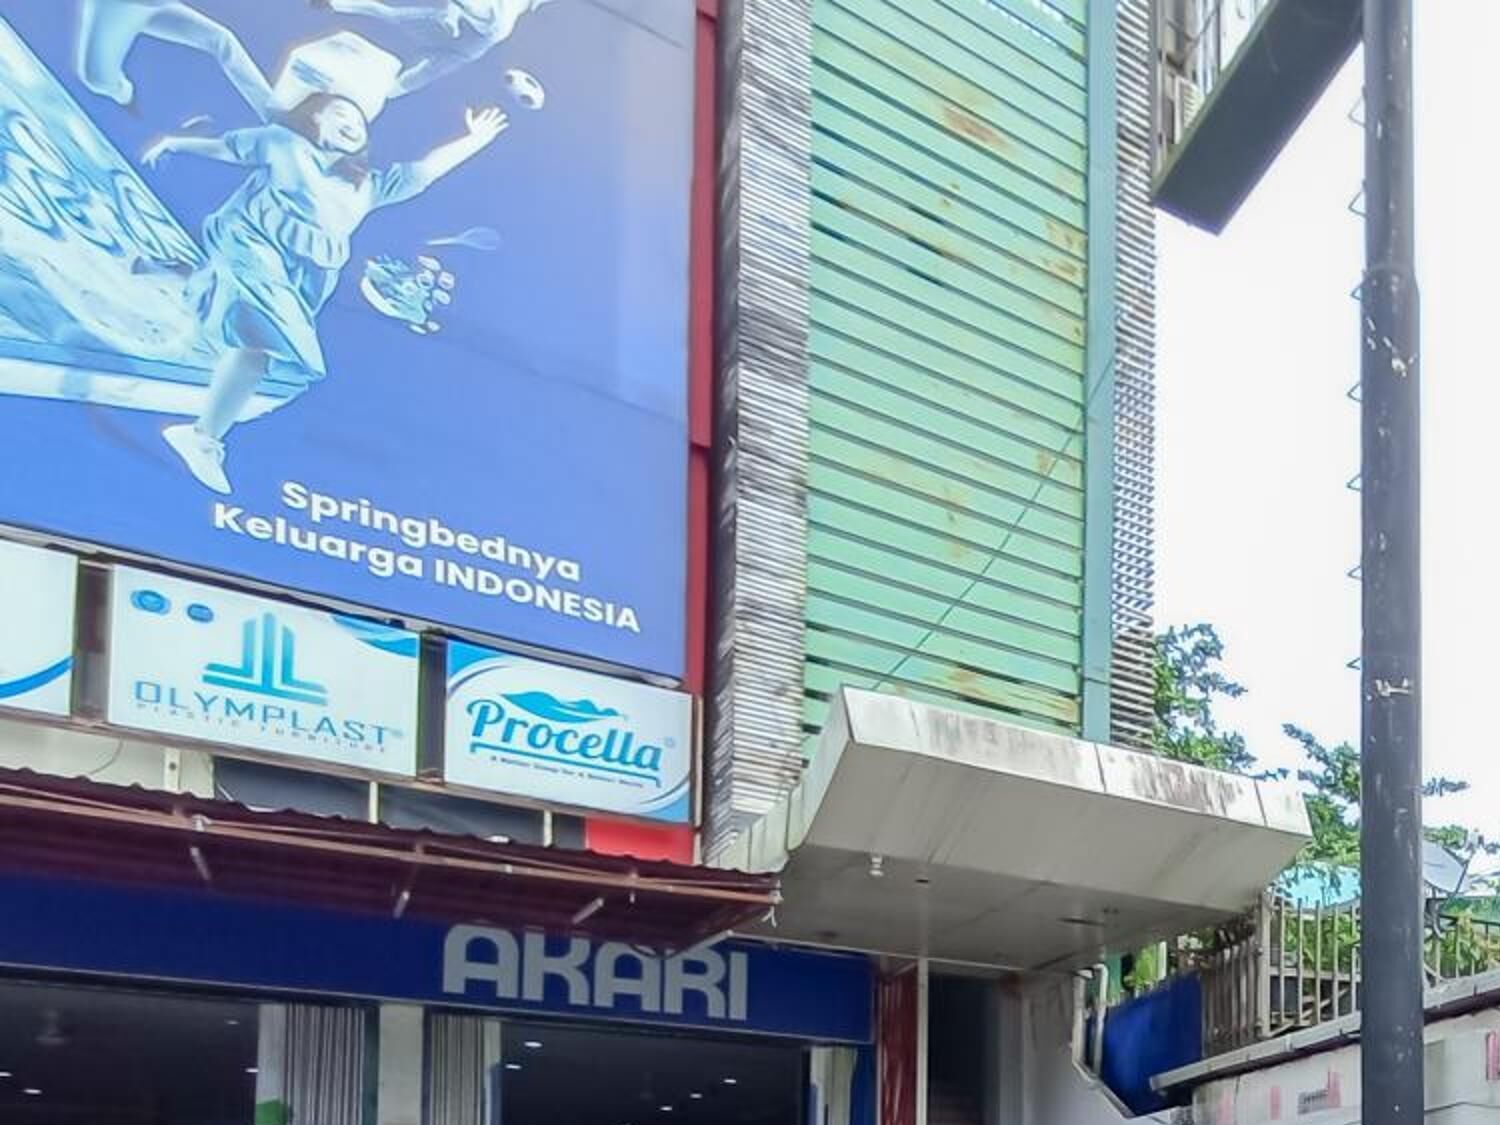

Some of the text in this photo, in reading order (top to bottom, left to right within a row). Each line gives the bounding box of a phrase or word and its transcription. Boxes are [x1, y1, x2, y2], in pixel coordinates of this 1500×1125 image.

[213, 502, 641, 633] Keluarga INDONESIA
[281, 480, 581, 582] Springbednya
[135, 680, 388, 745] OLYMPLAST
[466, 698, 663, 772] Procella
[442, 923, 749, 1021] AKARI
